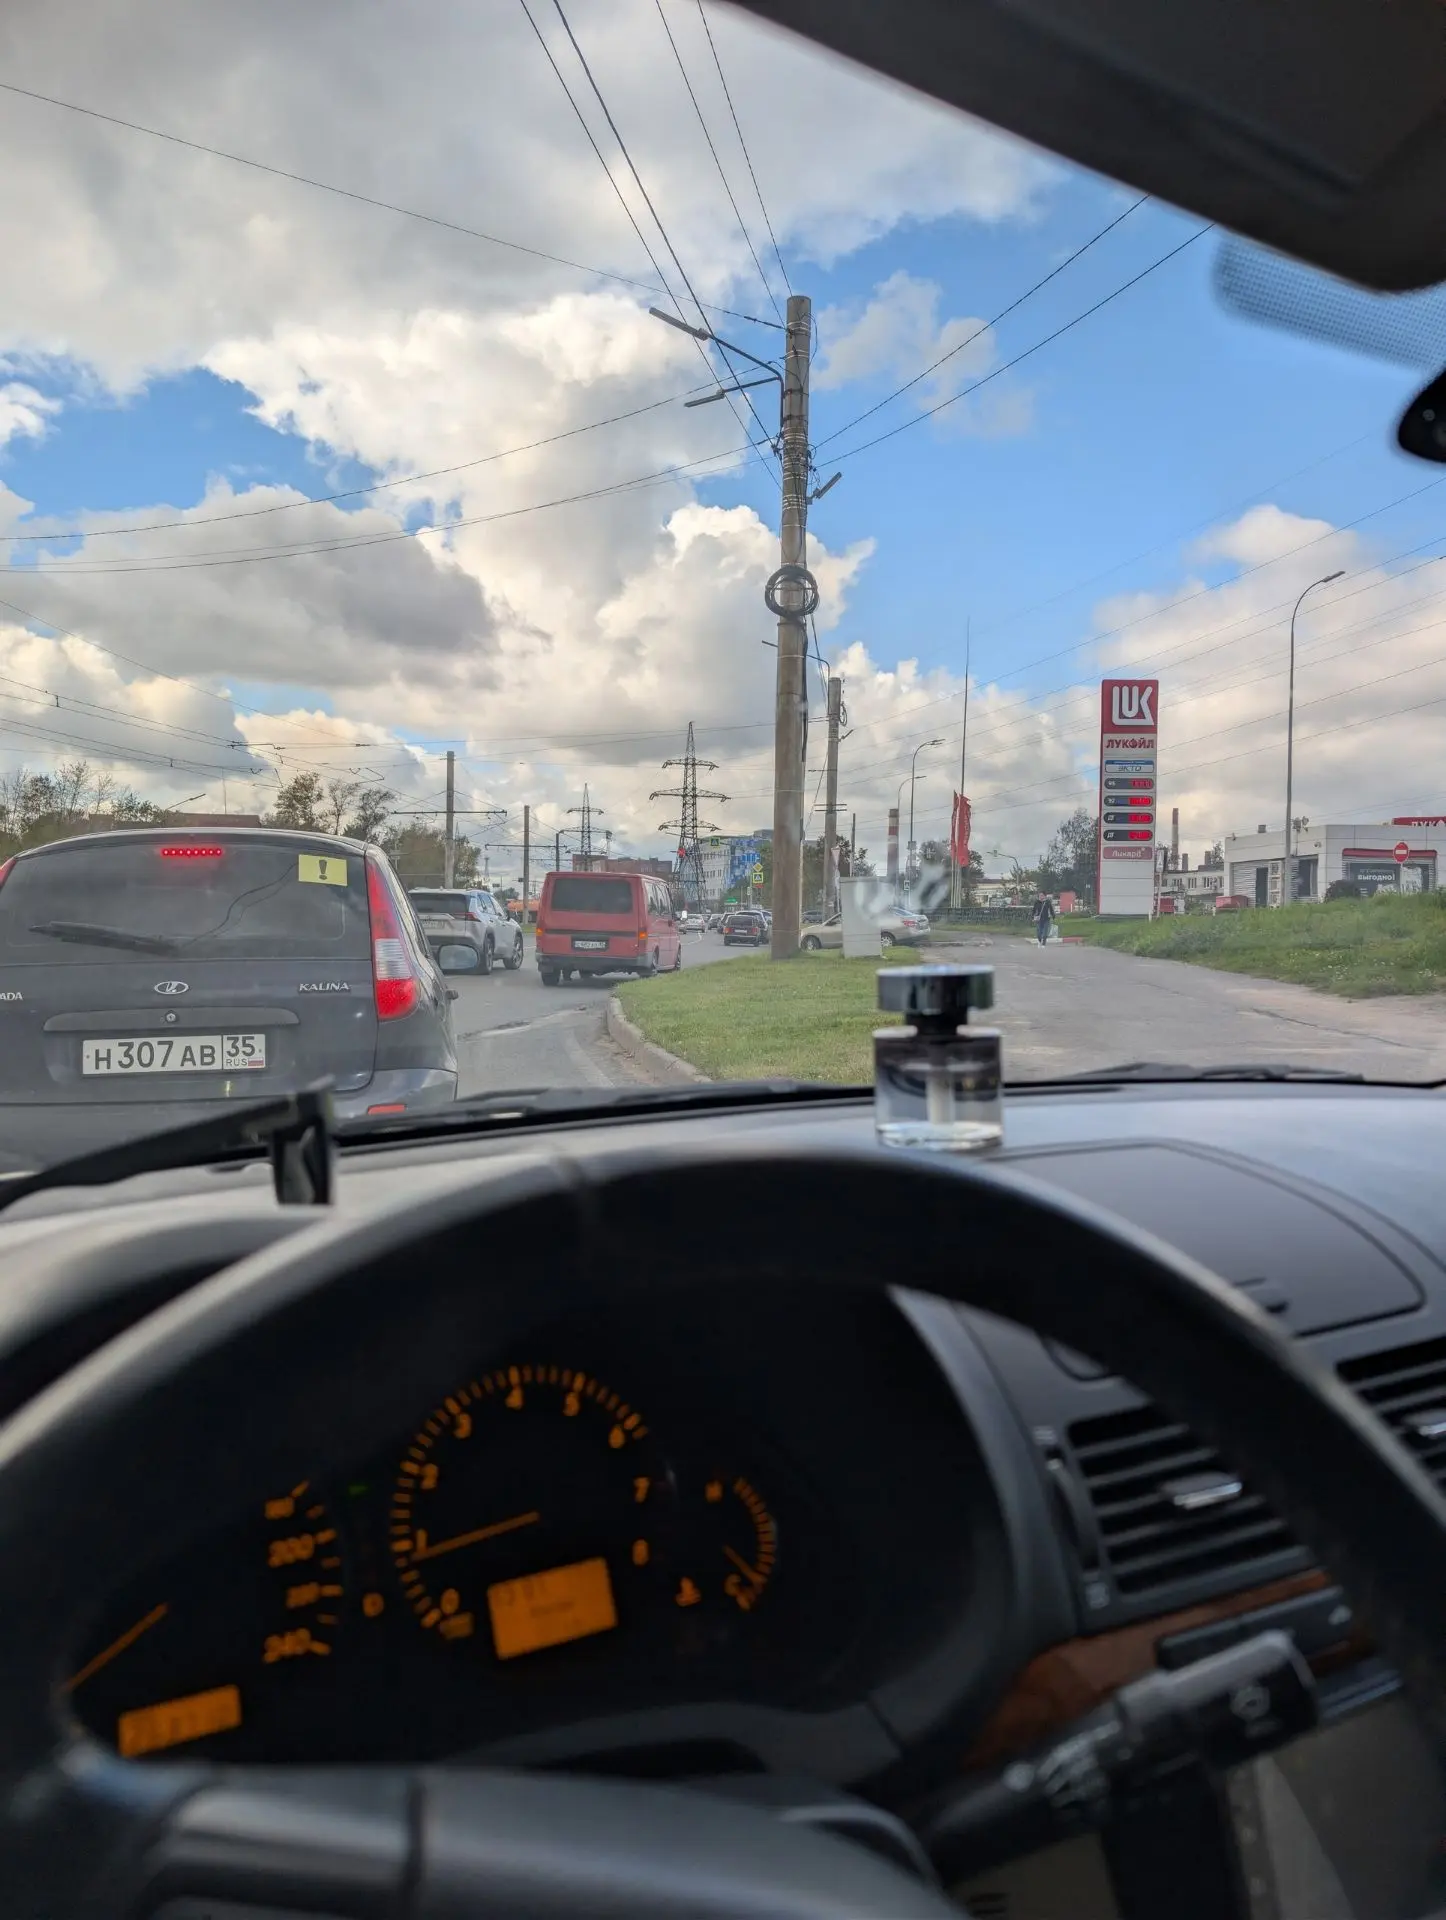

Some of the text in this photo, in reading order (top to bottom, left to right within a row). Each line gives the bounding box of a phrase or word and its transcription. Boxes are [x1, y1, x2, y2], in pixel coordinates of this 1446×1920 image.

[1106, 737, 1155, 748] ЛУКОЙЛ
[299, 982, 350, 992] KALINA
[226, 1036, 256, 1057] 35
[226, 1058, 248, 1067] RUS
